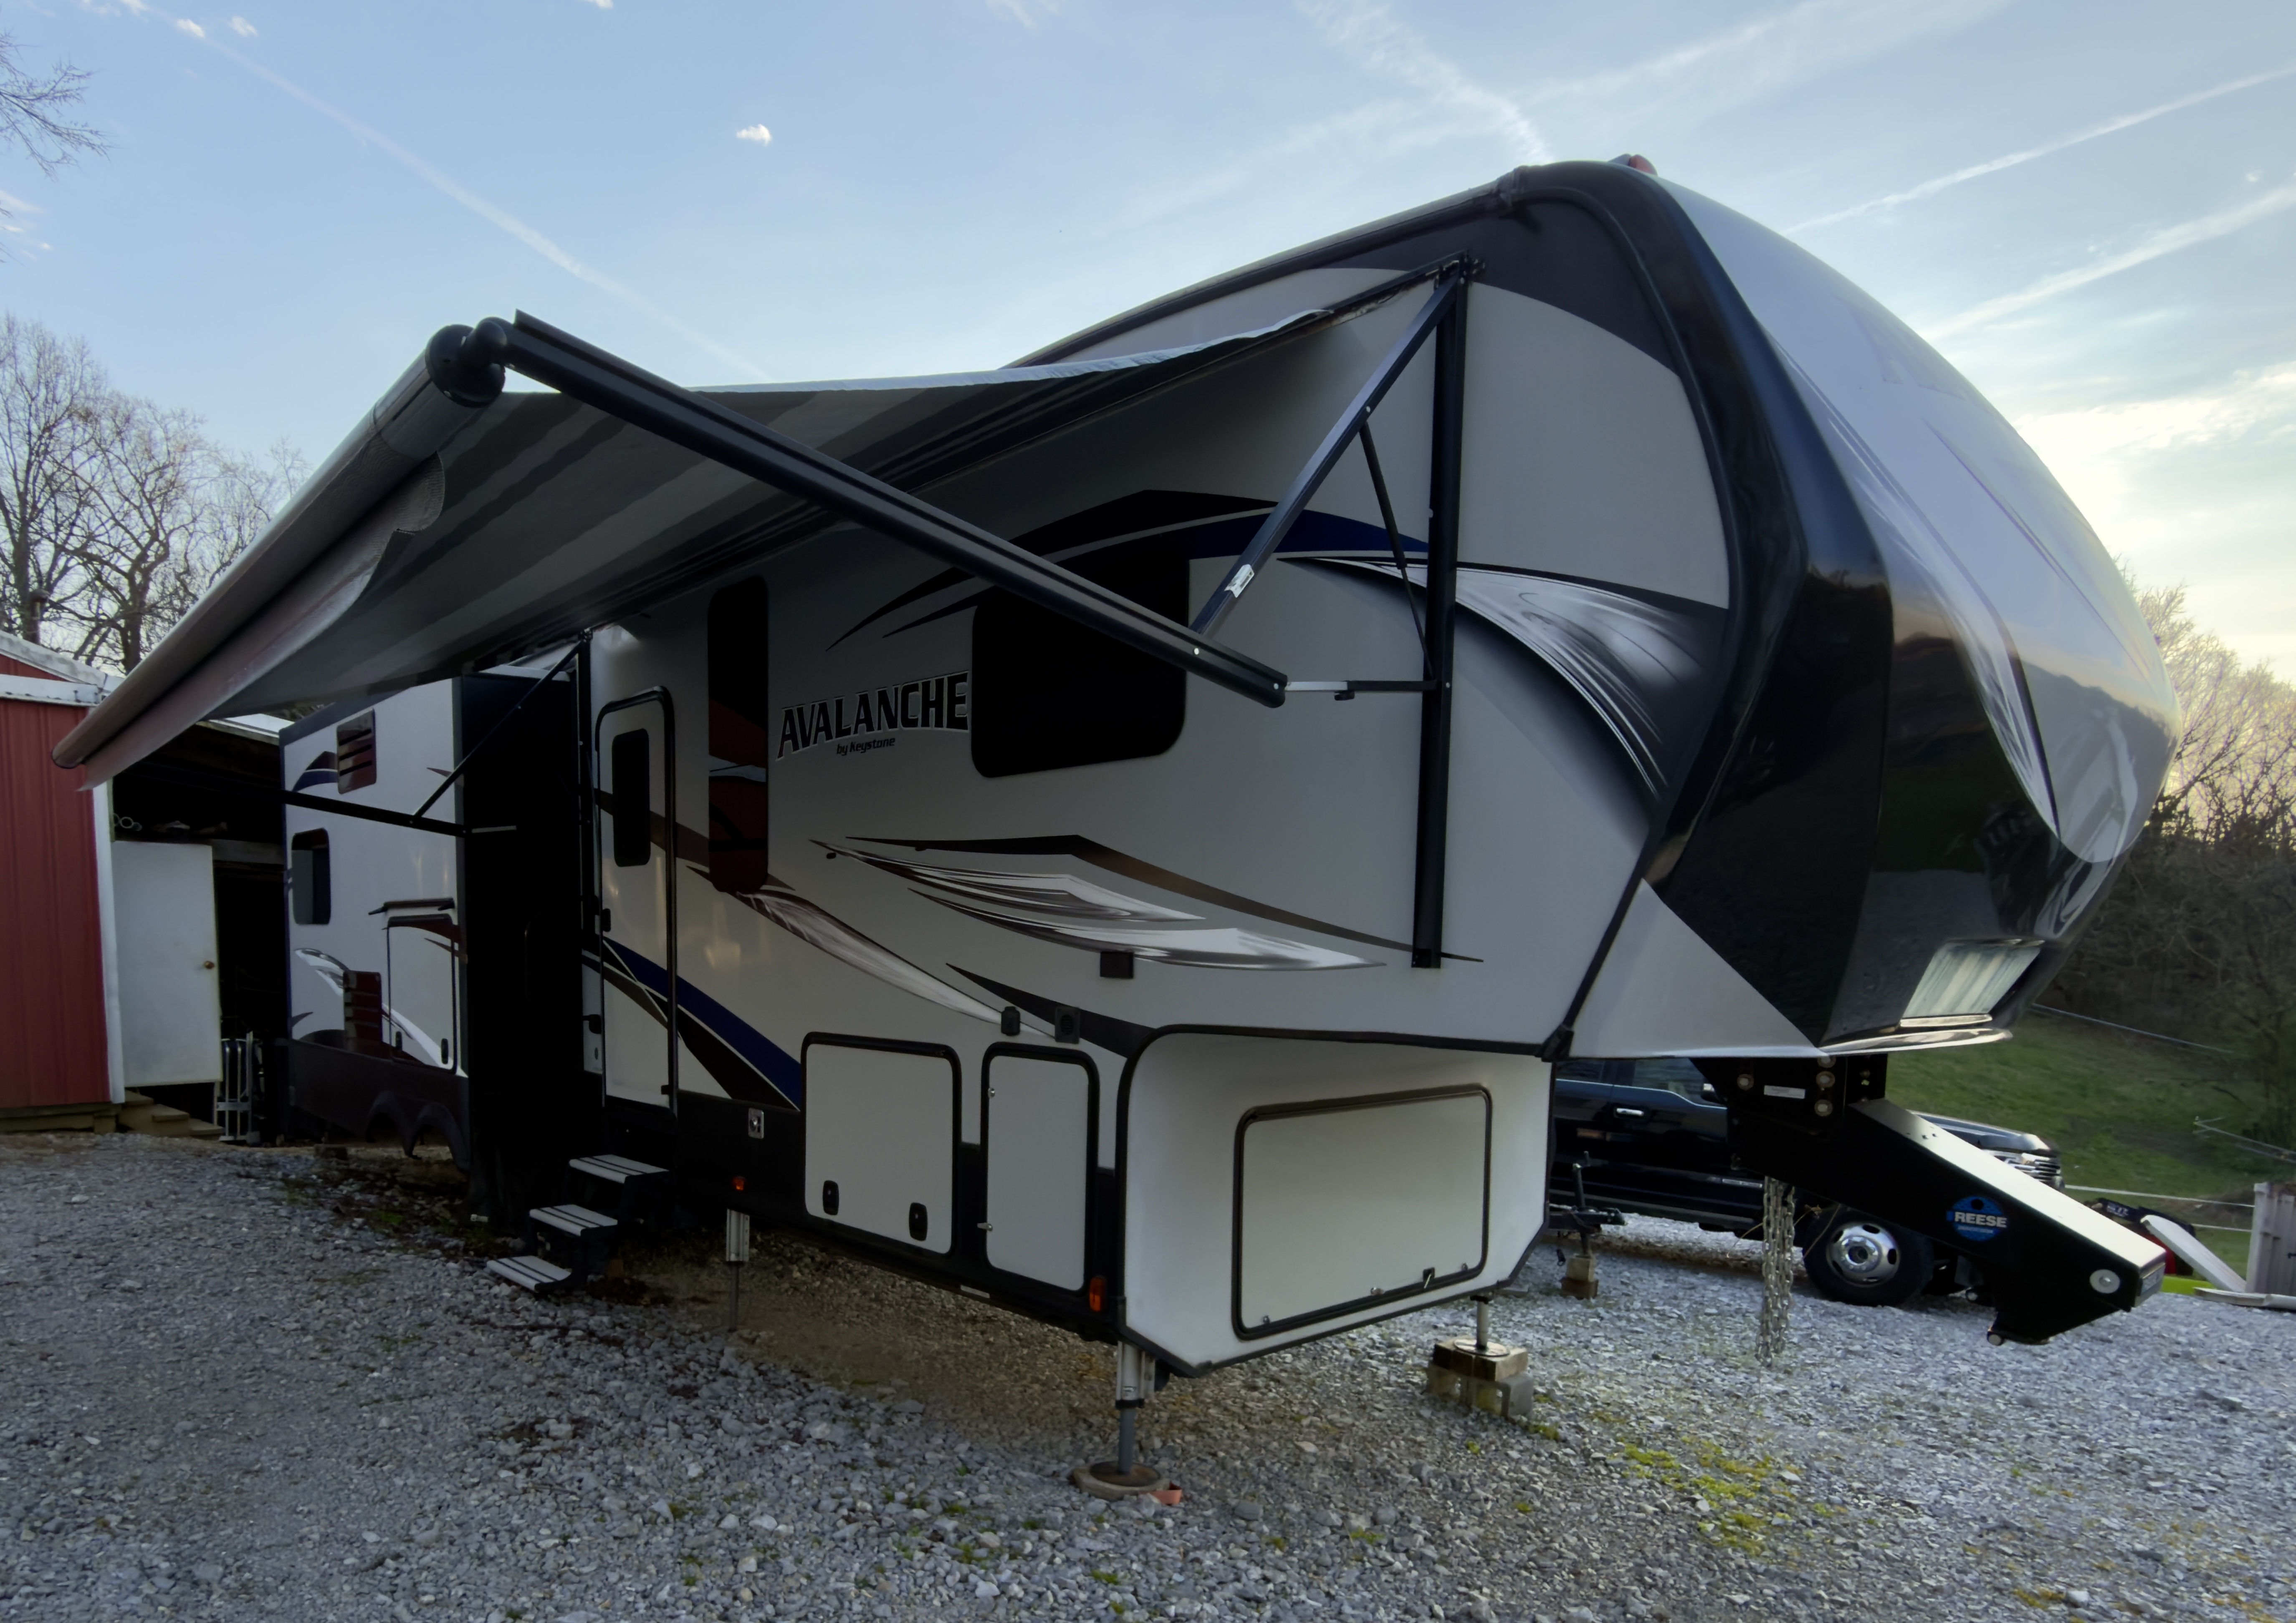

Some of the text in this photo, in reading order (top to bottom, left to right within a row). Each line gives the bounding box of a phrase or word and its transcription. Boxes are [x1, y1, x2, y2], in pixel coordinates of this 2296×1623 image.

[776, 670, 969, 761] AVALANCHE
[837, 738, 895, 756] by Keystone
[1954, 1212, 2008, 1228] REESE
